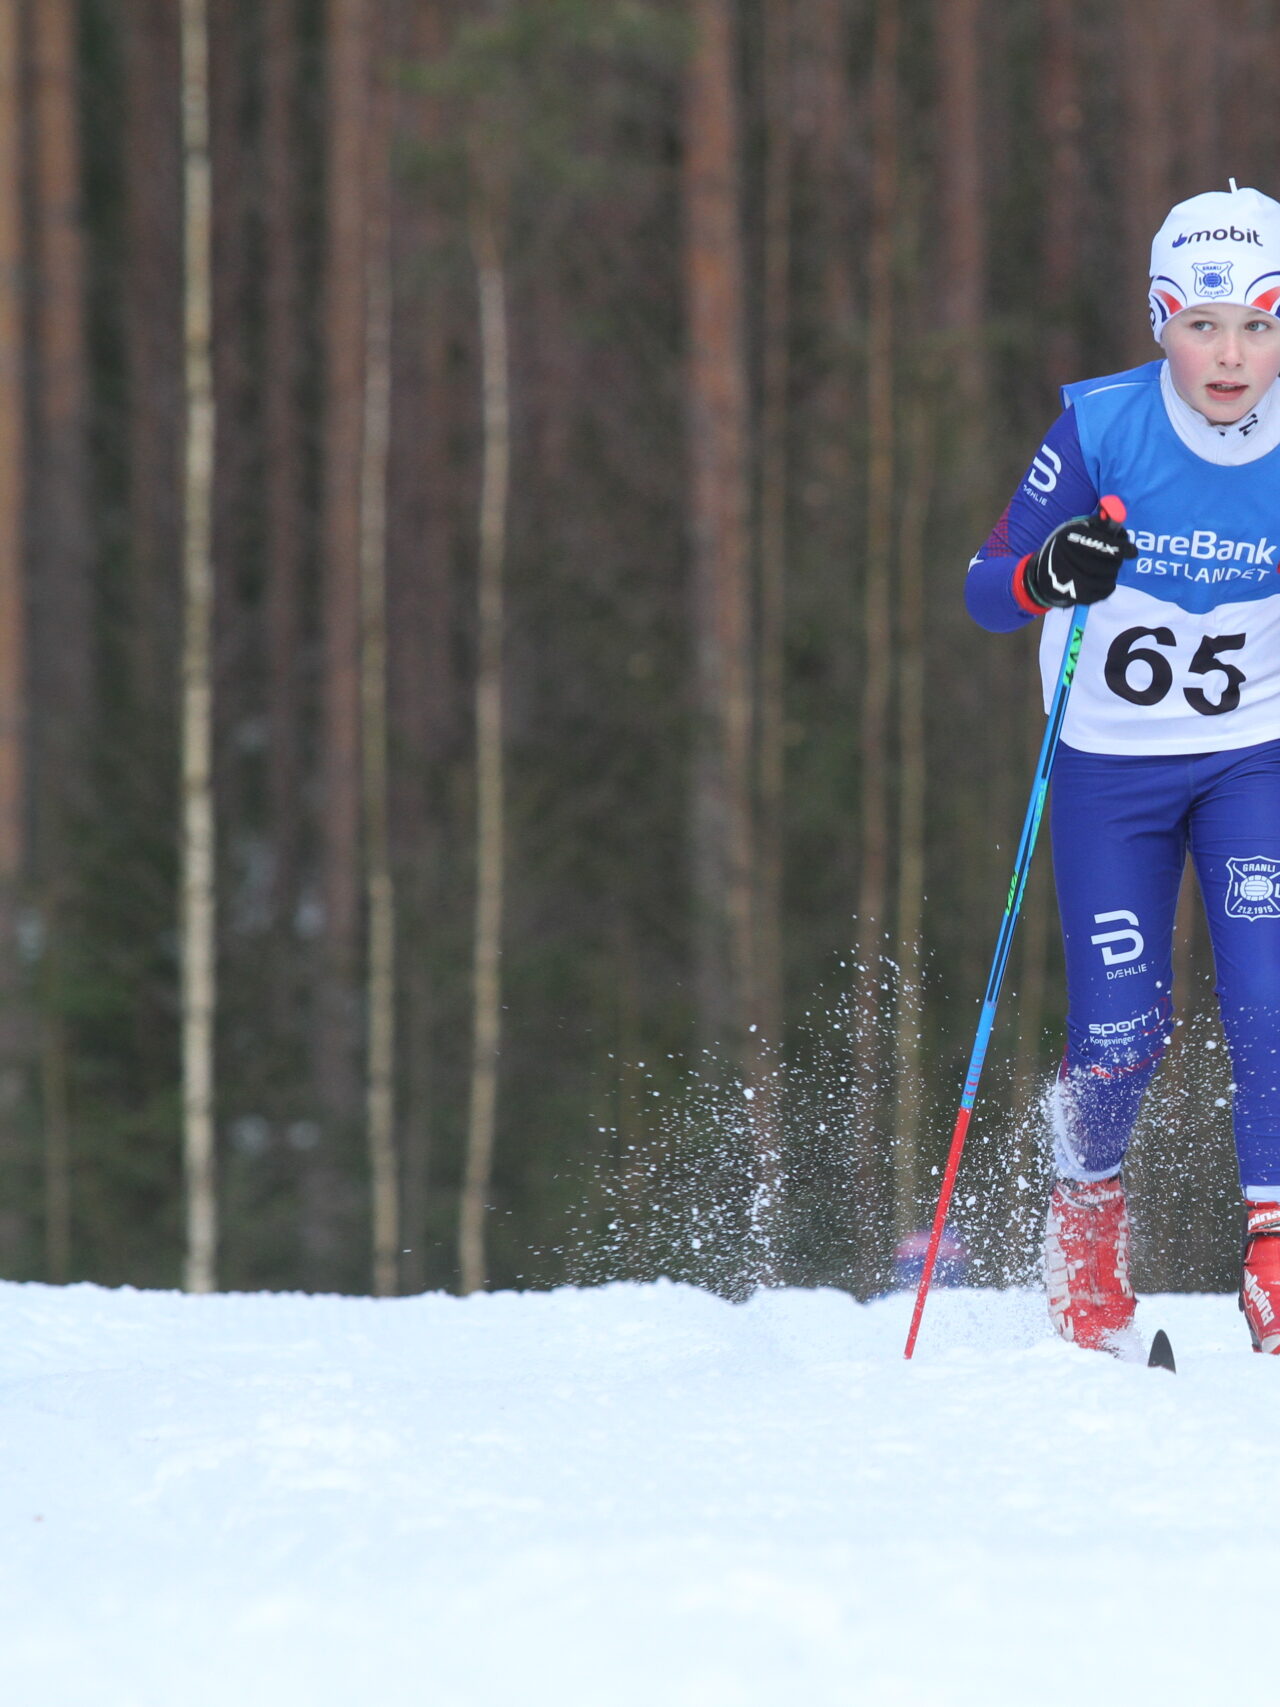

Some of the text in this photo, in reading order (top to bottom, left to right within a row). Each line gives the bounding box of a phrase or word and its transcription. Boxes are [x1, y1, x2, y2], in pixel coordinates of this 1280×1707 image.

[1187, 225, 1263, 247] mobit
[1136, 557, 1270, 584] ØSTLANDET
[1104, 625, 1247, 716] 65
[1242, 863, 1276, 873] GRANLI
[1237, 905, 1274, 915] 21.2.1915
[1106, 963, 1148, 981] DÆHLIE
[1088, 1013, 1149, 1038] sport
[1089, 1034, 1136, 1048] Kongsvinger
